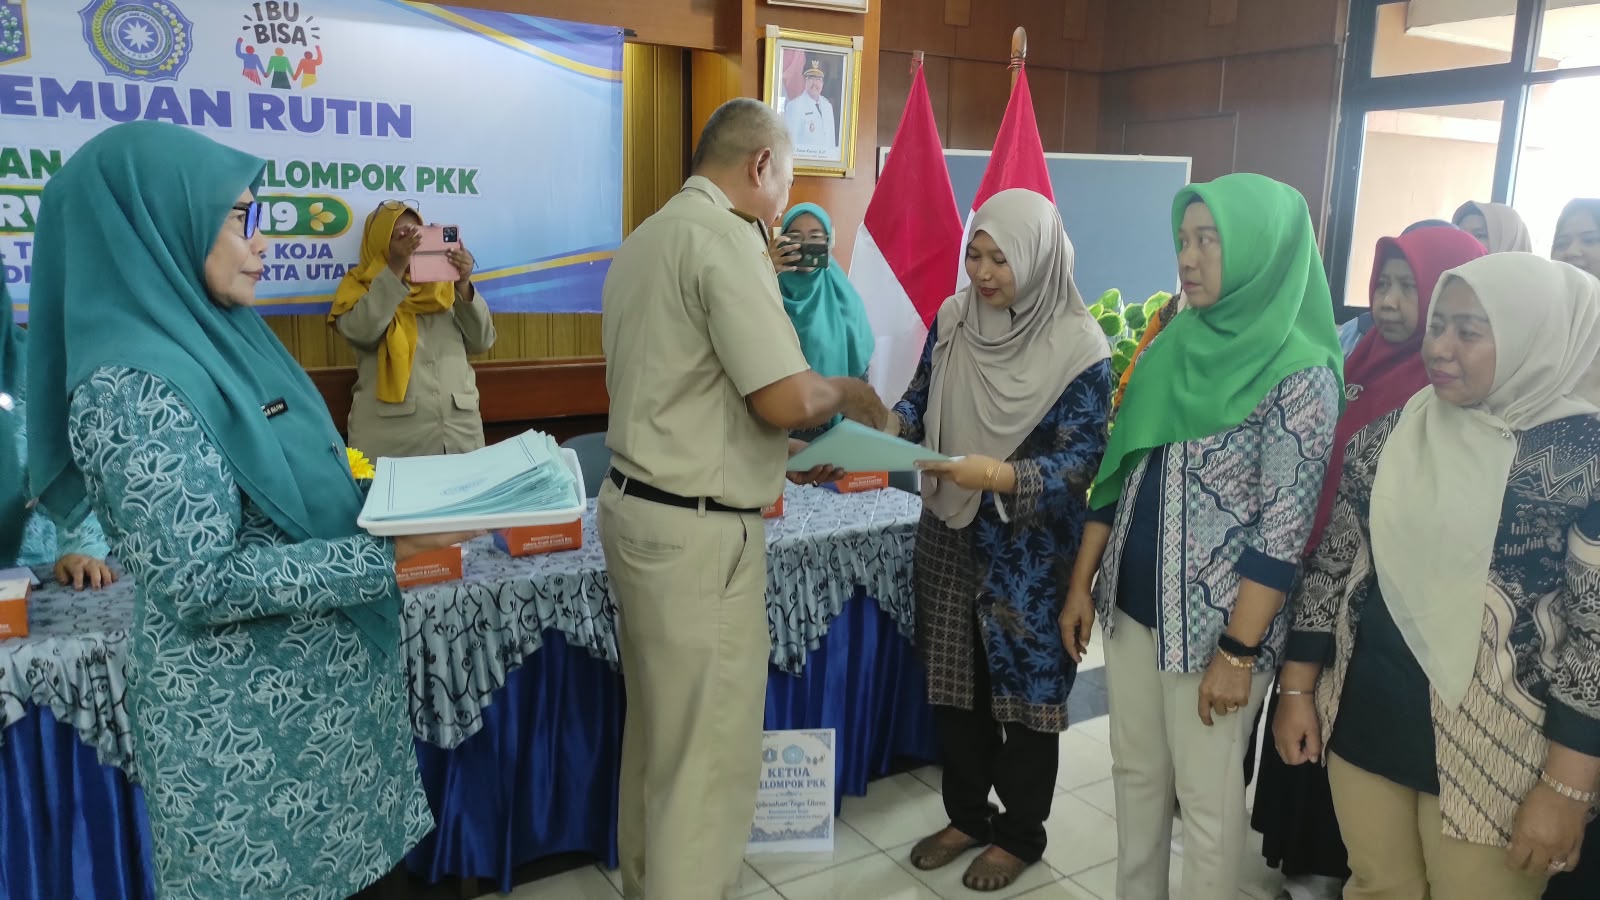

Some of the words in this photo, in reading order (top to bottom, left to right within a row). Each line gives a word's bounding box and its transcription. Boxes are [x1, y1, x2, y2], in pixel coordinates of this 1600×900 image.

[253, 1, 299, 22] IBU
[253, 23, 307, 46] BISA
[248, 92, 412, 139] RUTIN
[259, 160, 406, 191] LOMPOK
[416, 166, 479, 194] PKK
[274, 243, 333, 259] KOJA
[767, 767, 811, 778] KETUA
[806, 778, 827, 789] PKK
